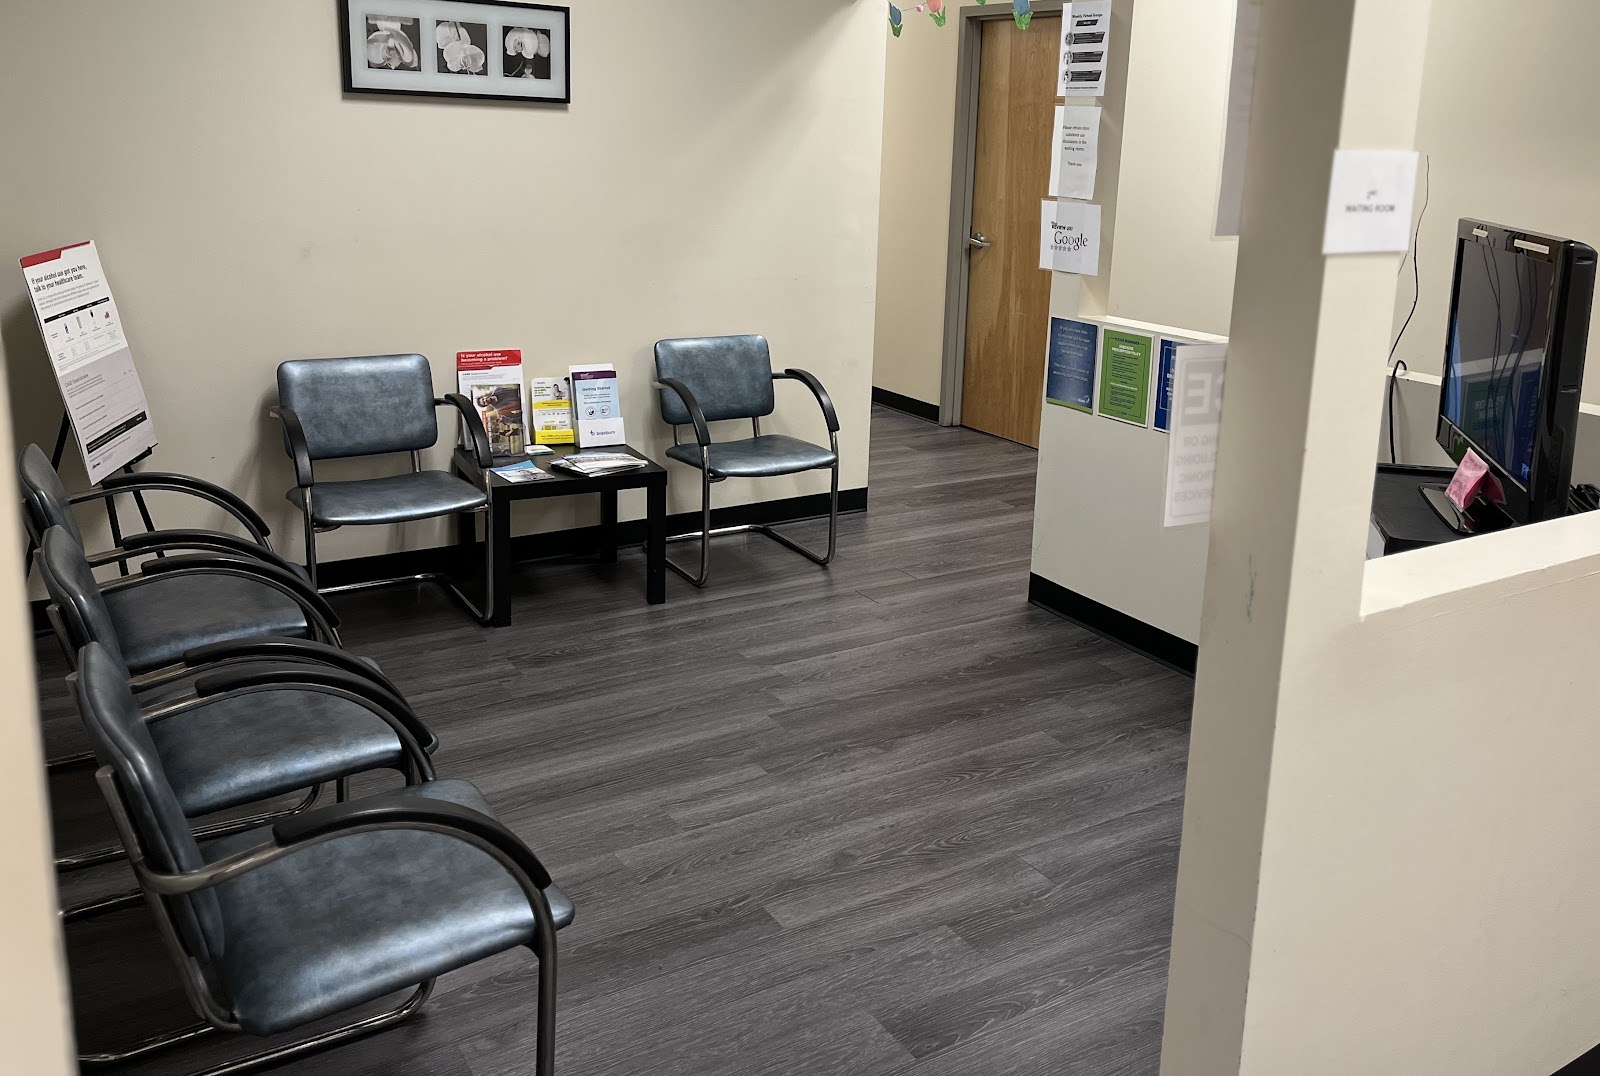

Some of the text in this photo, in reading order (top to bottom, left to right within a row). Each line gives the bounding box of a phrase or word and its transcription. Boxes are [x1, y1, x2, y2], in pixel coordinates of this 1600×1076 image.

[1346, 204, 1373, 212] WAITING
[1054, 231, 1088, 250] Google
[44, 272, 57, 280] alcohol
[54, 276, 73, 286] healthcare
